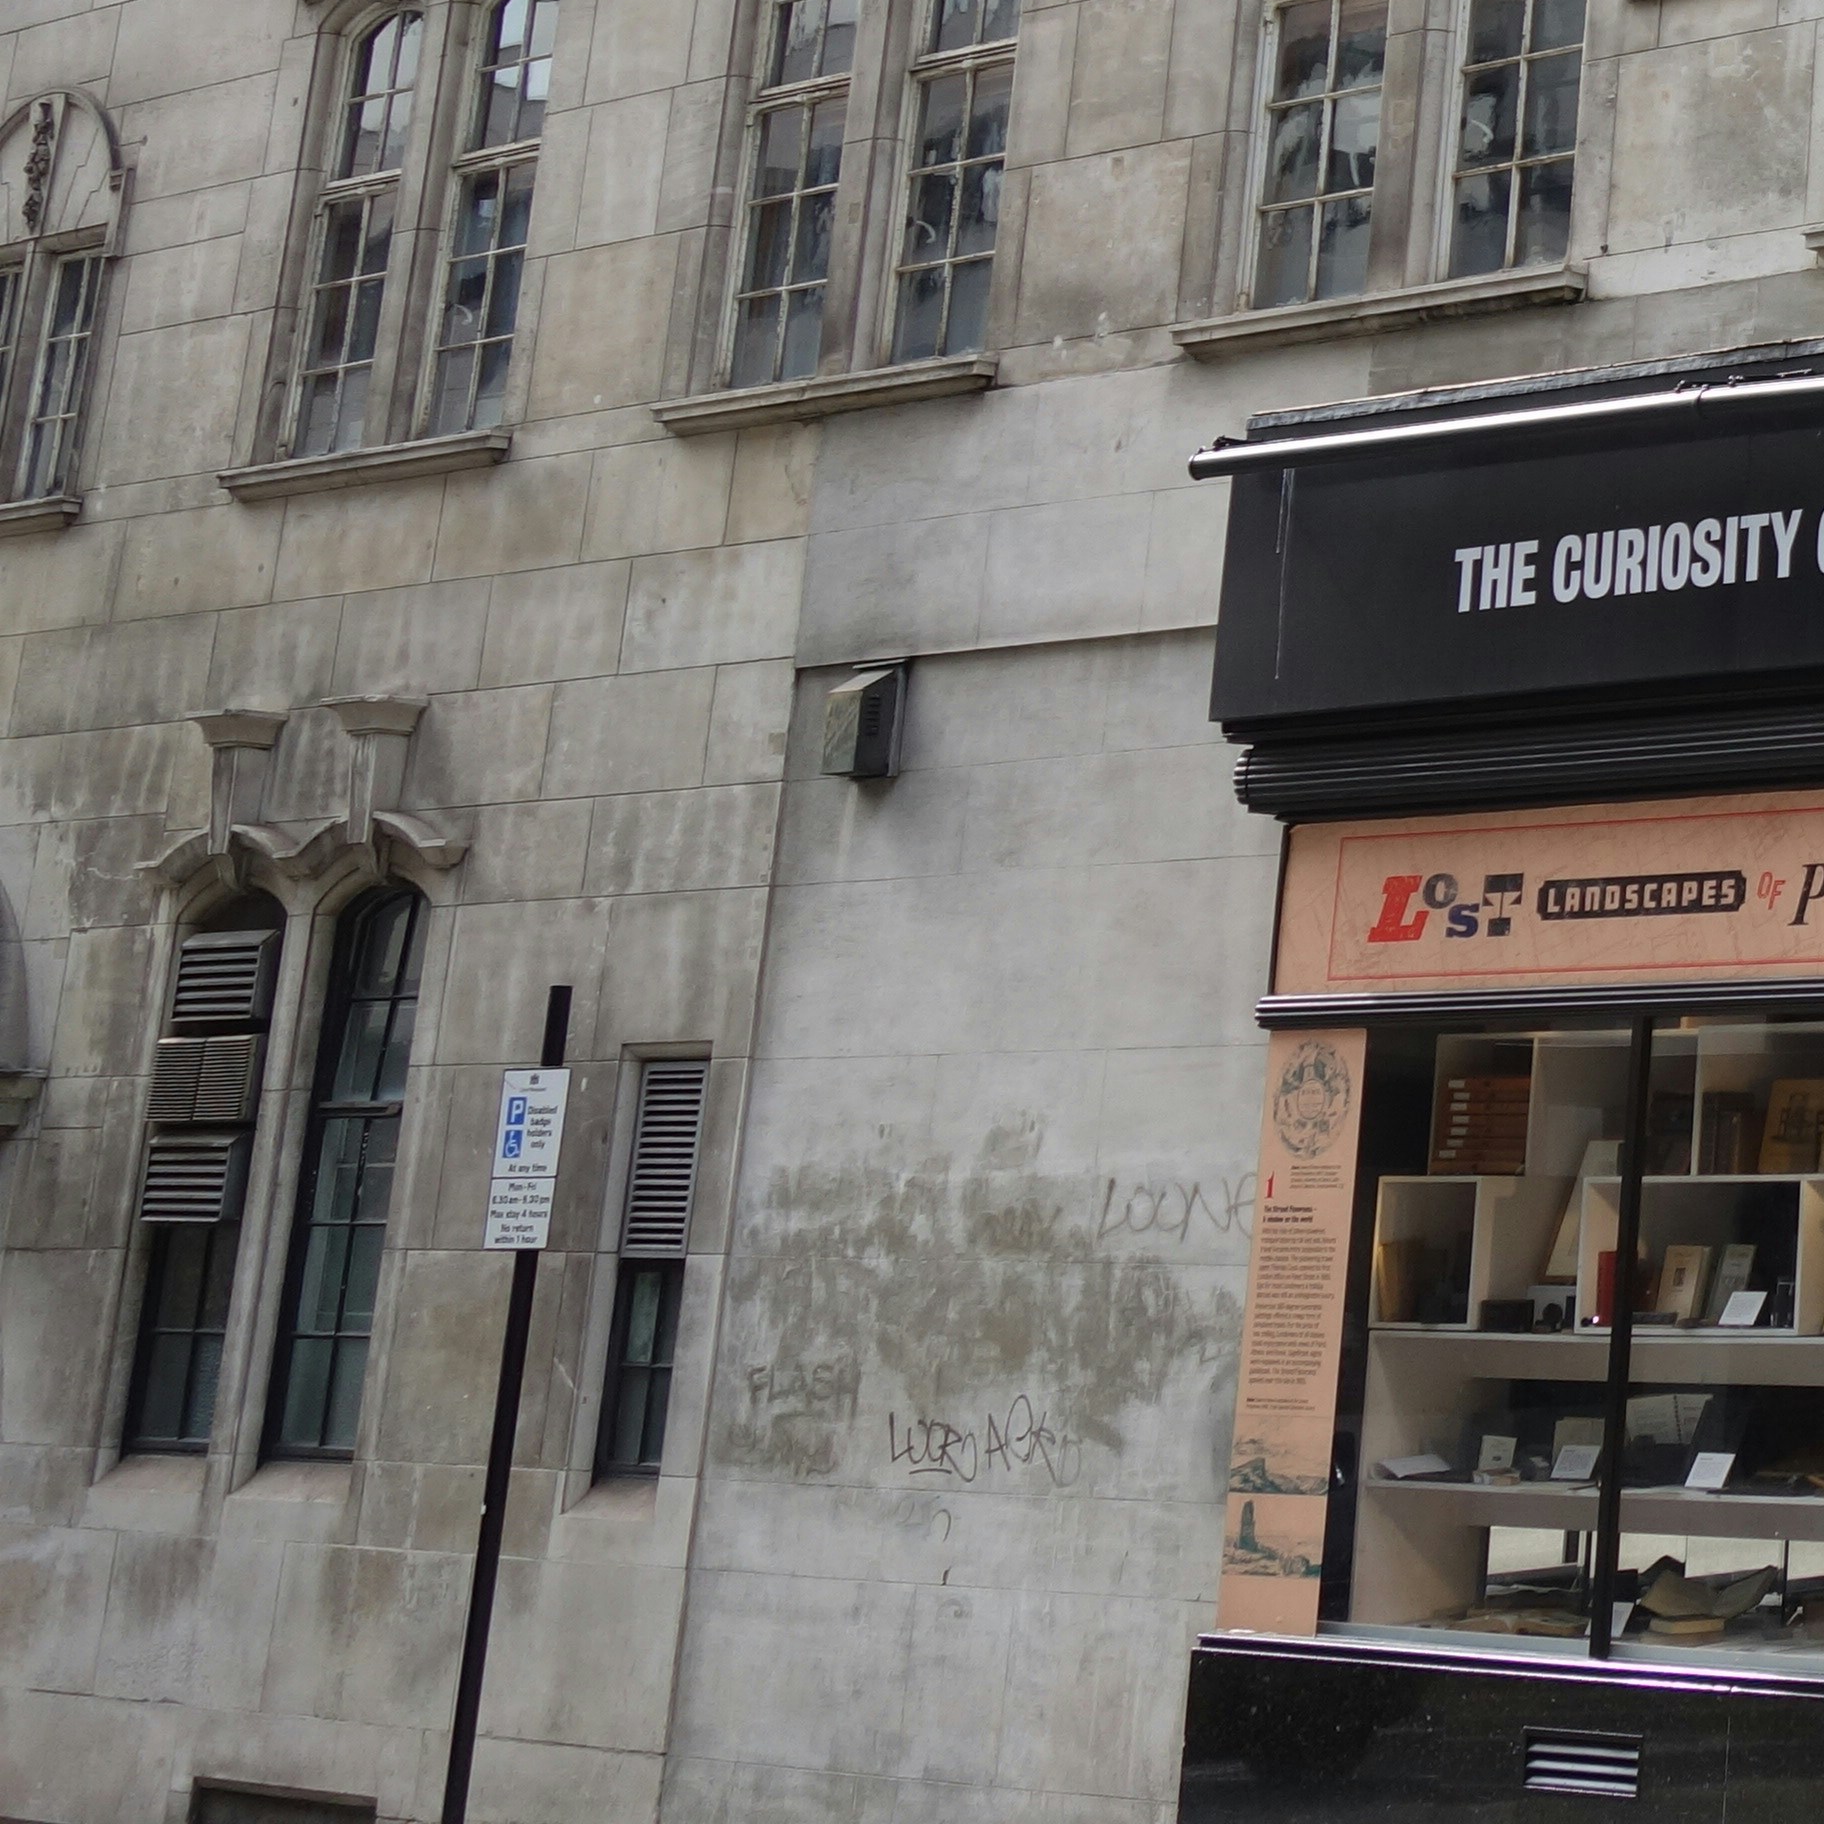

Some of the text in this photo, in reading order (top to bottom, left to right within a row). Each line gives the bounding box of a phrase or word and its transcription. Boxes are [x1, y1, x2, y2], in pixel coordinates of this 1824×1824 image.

[1454, 539, 1539, 613] THE
[1552, 509, 1803, 604] CURIOSITY
[1367, 872, 1525, 944] LOST
[1544, 877, 1738, 916] LANDSCAPES
[1756, 871, 1786, 910] OF
[530, 1140, 546, 1150] only
[518, 1165, 530, 1175] any
[532, 1163, 548, 1172] time
[1264, 1170, 1274, 1199] 1
[529, 1210, 548, 1218] hours
[512, 1224, 534, 1233] return
[521, 1234, 538, 1244] hour
